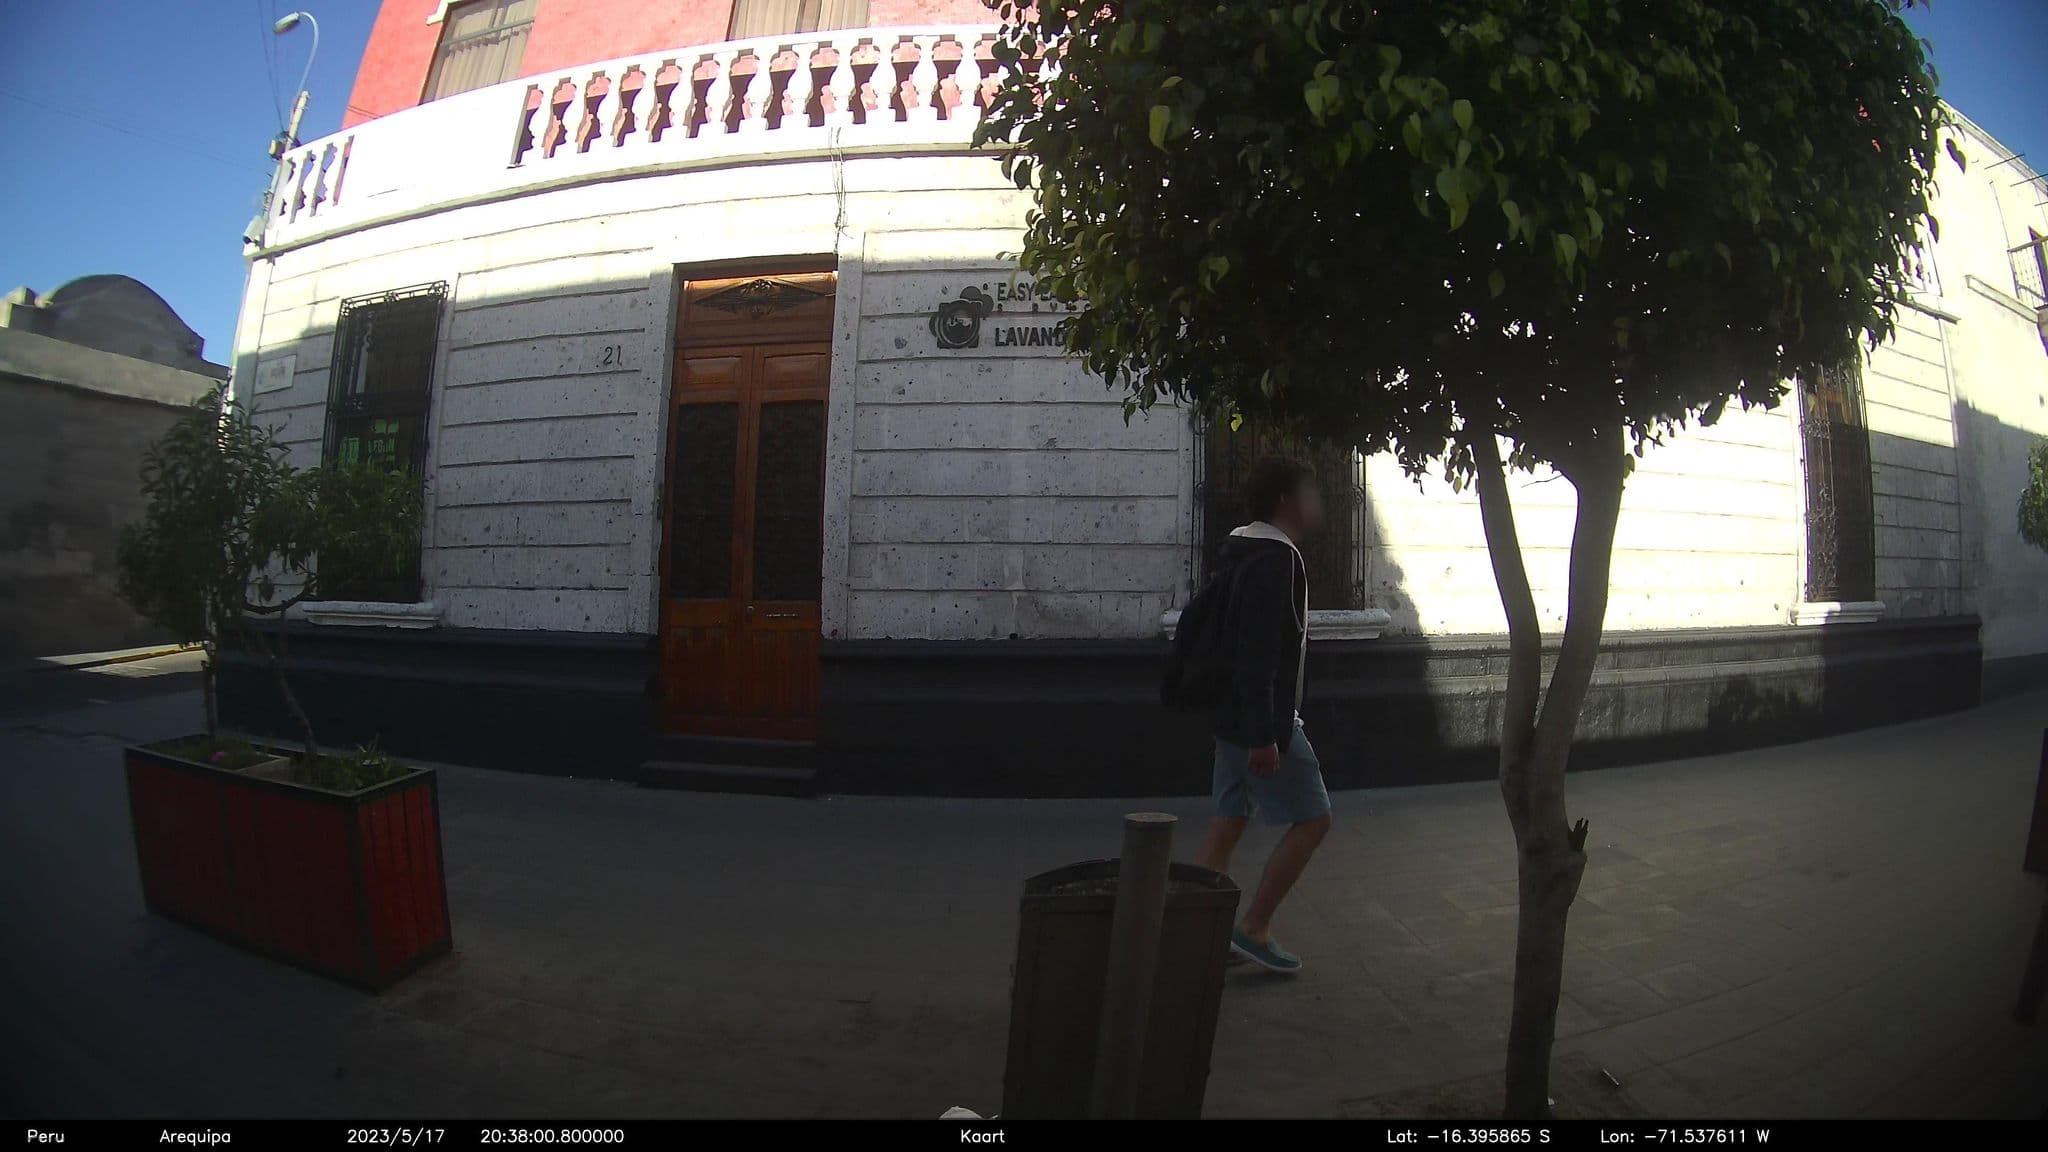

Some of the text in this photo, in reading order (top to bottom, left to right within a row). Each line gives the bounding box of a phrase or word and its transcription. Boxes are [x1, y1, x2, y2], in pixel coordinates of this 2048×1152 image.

[997, 281, 1037, 302] EASY
[994, 326, 1067, 347] LAVAND
[602, 345, 622, 366] 21
